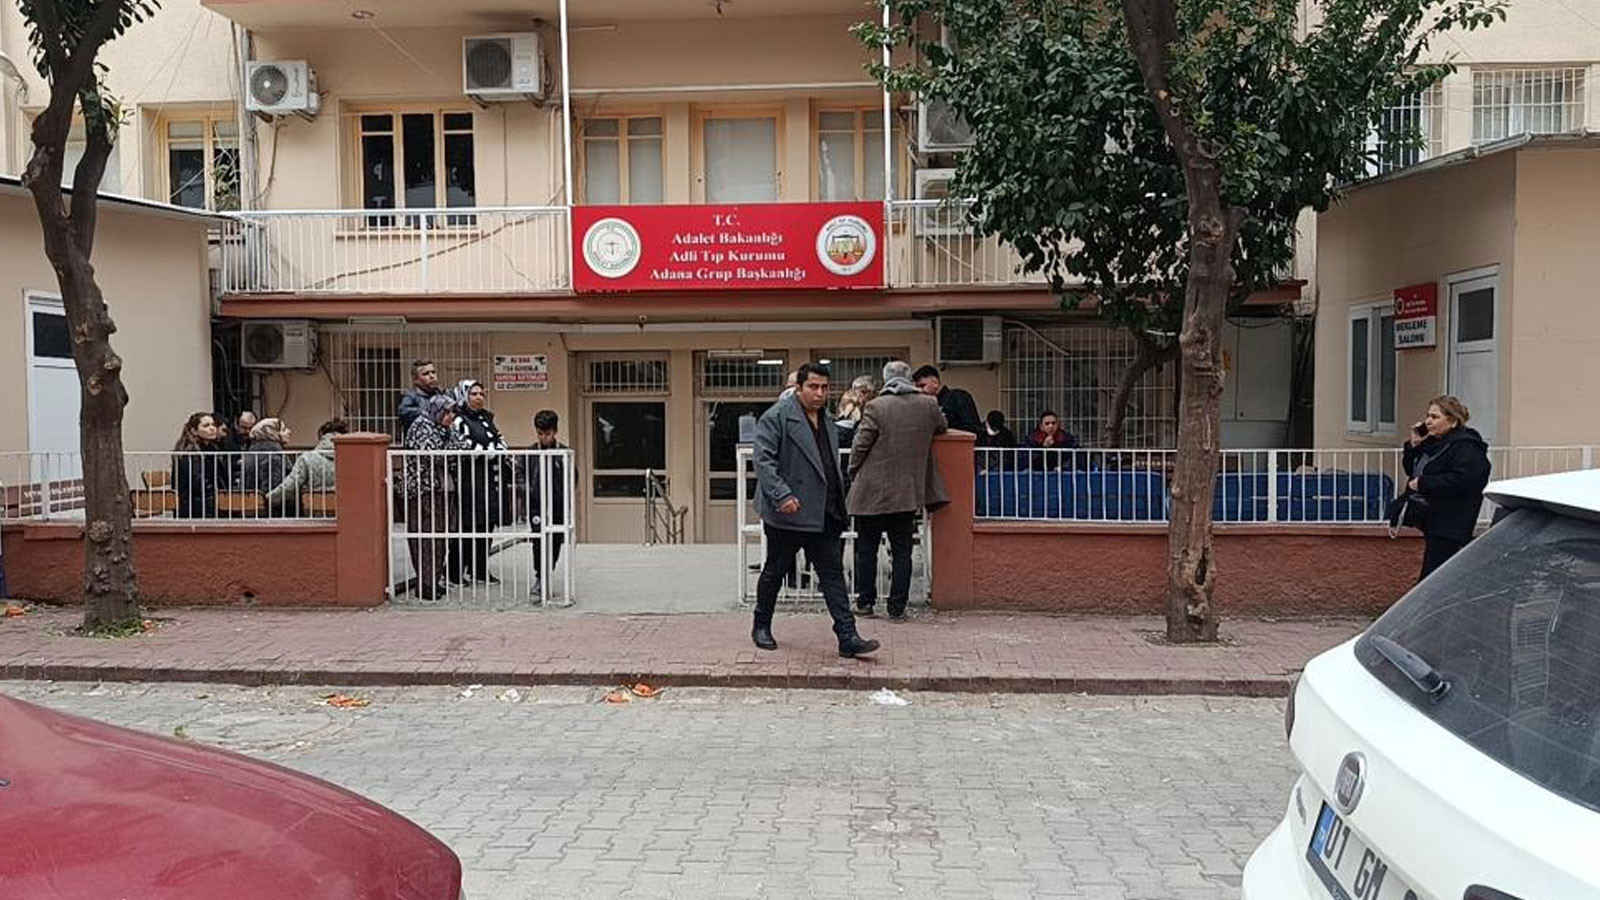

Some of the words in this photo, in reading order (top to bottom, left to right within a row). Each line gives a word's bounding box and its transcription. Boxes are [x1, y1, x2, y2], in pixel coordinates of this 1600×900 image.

[712, 213, 740, 226] T.C.
[672, 232, 715, 244] Adalet
[719, 232, 782, 246] Bakanlığı
[670, 250, 698, 262] Adli
[700, 250, 724, 264] Tıp
[728, 250, 785, 261] Kurumu
[650, 268, 693, 279] Adana
[696, 267, 732, 281] Grup
[737, 267, 806, 281] Başkanlığı
[1324, 814, 1351, 870] 01
